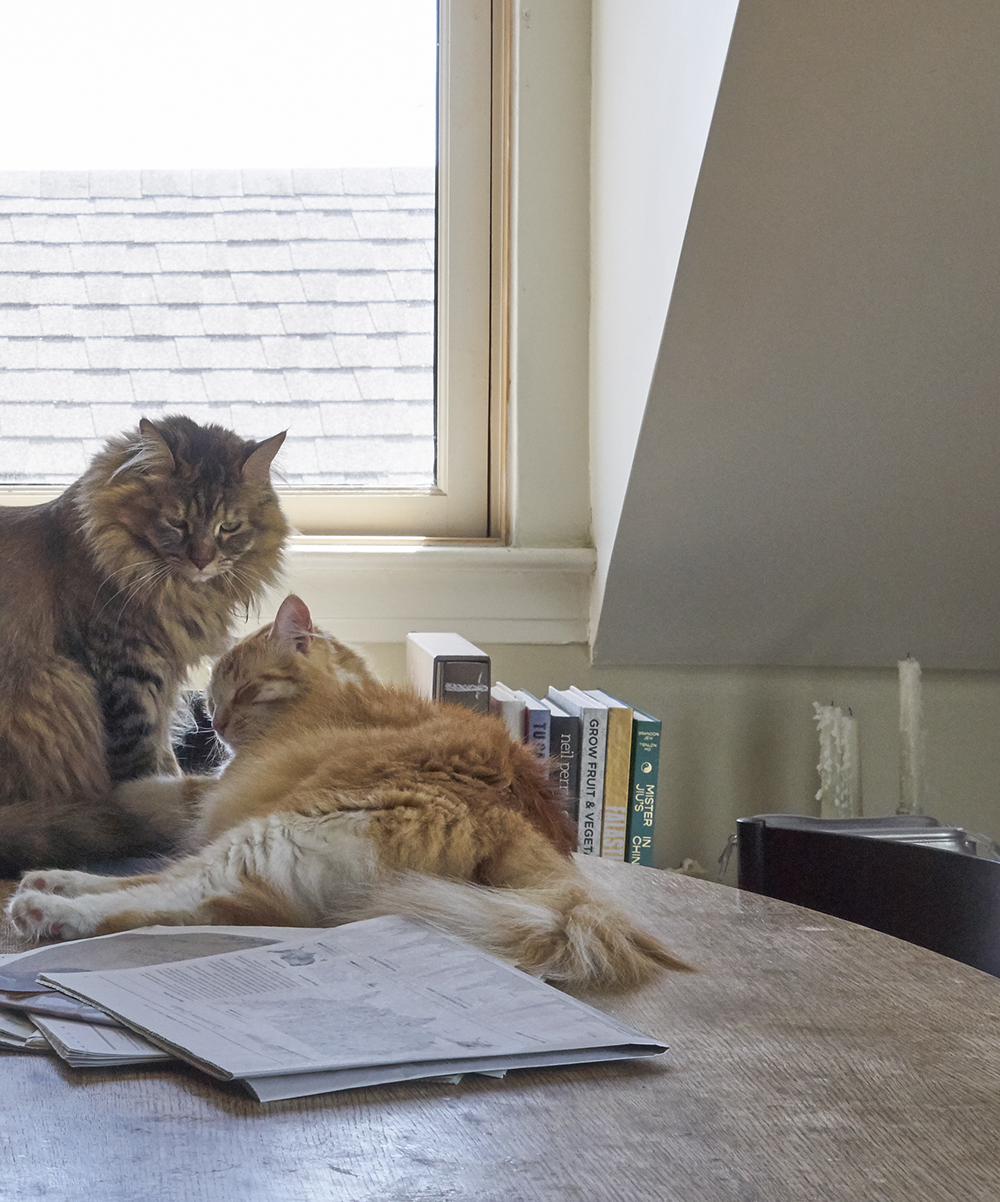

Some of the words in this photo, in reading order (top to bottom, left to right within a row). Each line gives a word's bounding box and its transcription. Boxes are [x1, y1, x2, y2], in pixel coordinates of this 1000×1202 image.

[560, 734, 574, 759] neil
[588, 719, 599, 759] GROW
[586, 762, 597, 798] FRUIT
[585, 801, 595, 809] &
[634, 783, 645, 812] JIU'S
[643, 784, 655, 827] MISTER
[642, 836, 652, 848] IN
